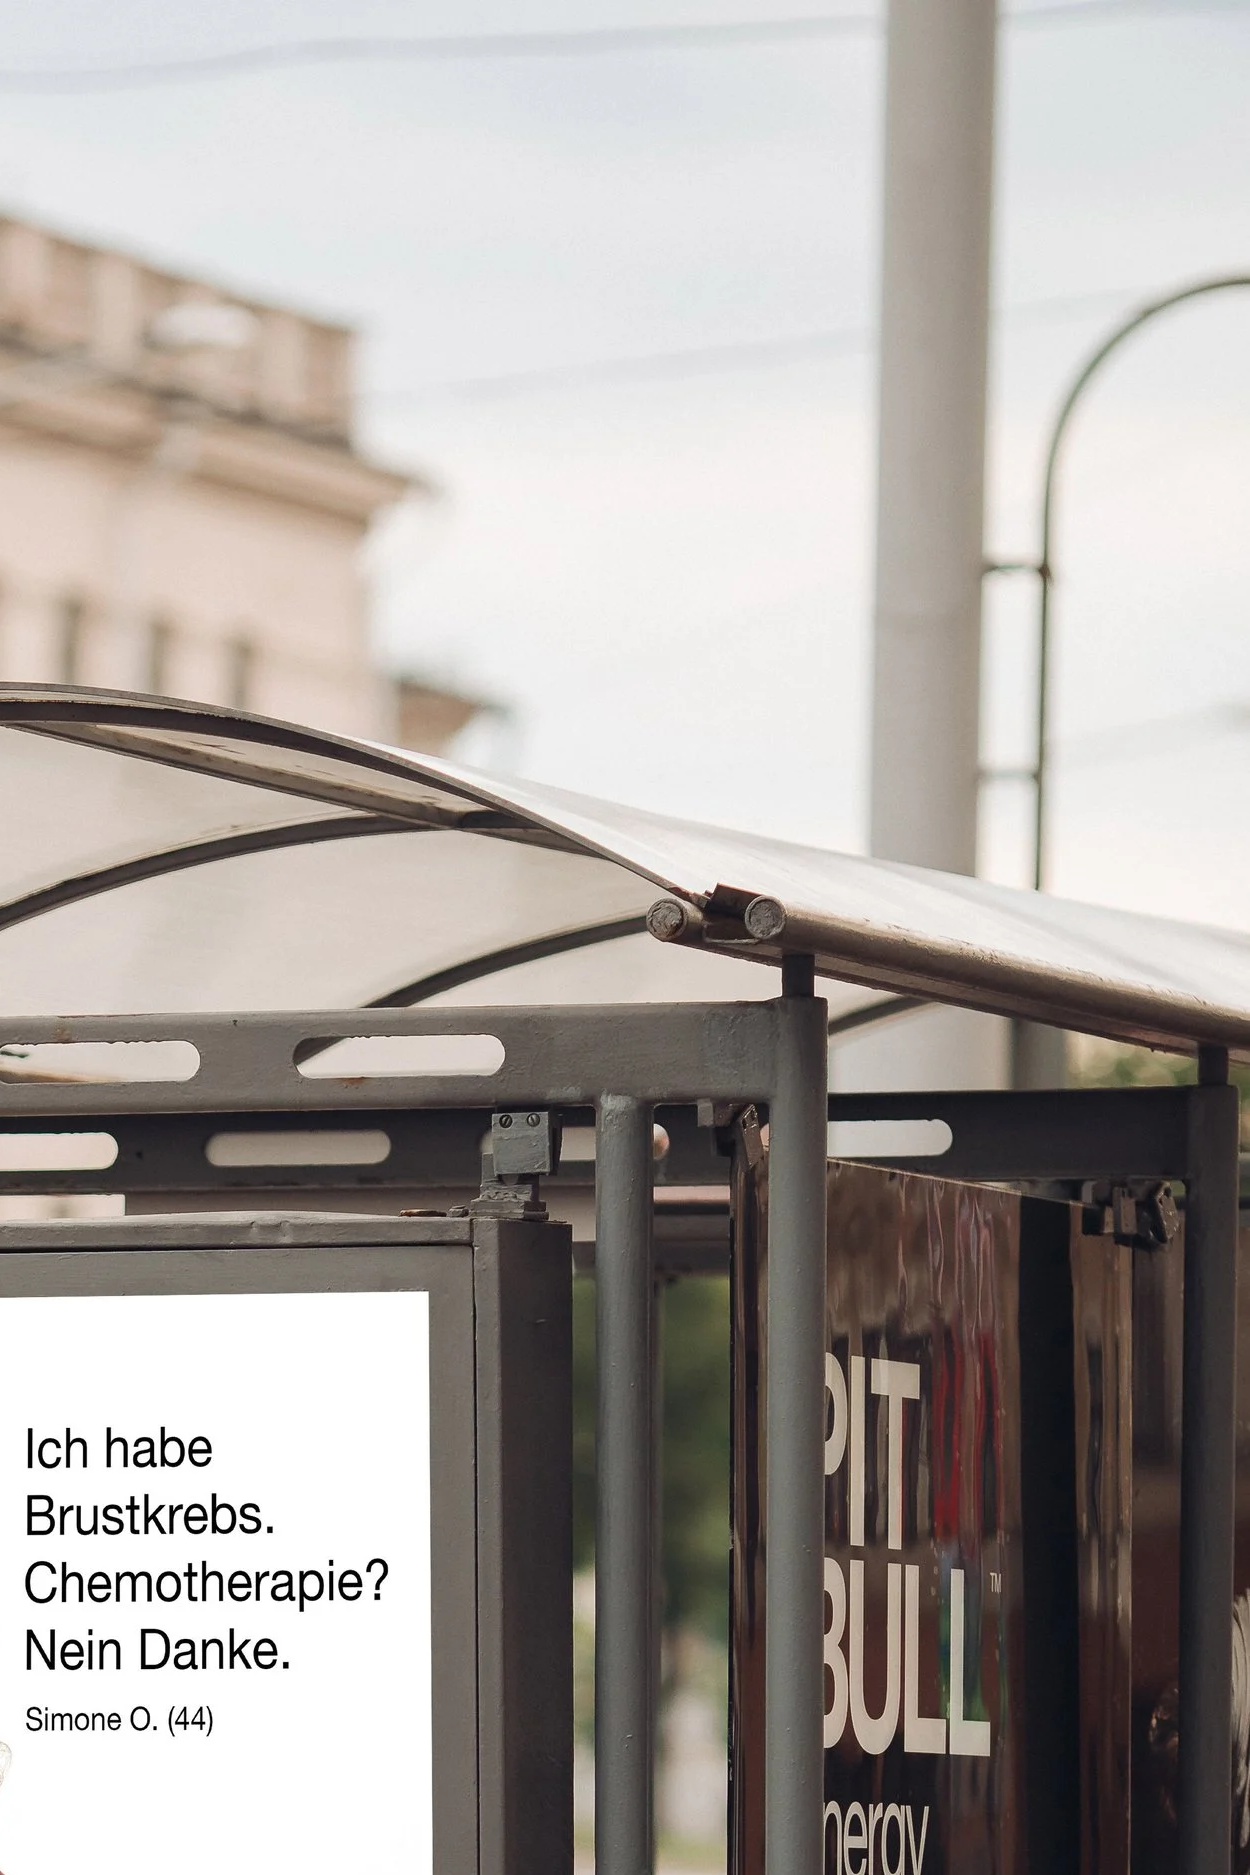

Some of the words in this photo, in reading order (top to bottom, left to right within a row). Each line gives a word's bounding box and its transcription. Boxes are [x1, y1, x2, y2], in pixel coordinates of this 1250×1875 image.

[27, 1427, 88, 1469] Ich
[106, 1426, 213, 1469] habe
[26, 1492, 274, 1536] Brustkrebs.
[24, 1557, 389, 1613] Chemotherapie?
[26, 1628, 121, 1671] Nein
[140, 1627, 290, 1671] Danke.
[25, 1706, 122, 1732] Simone
[129, 1705, 158, 1732] O.
[168, 1705, 214, 1738] (44)
